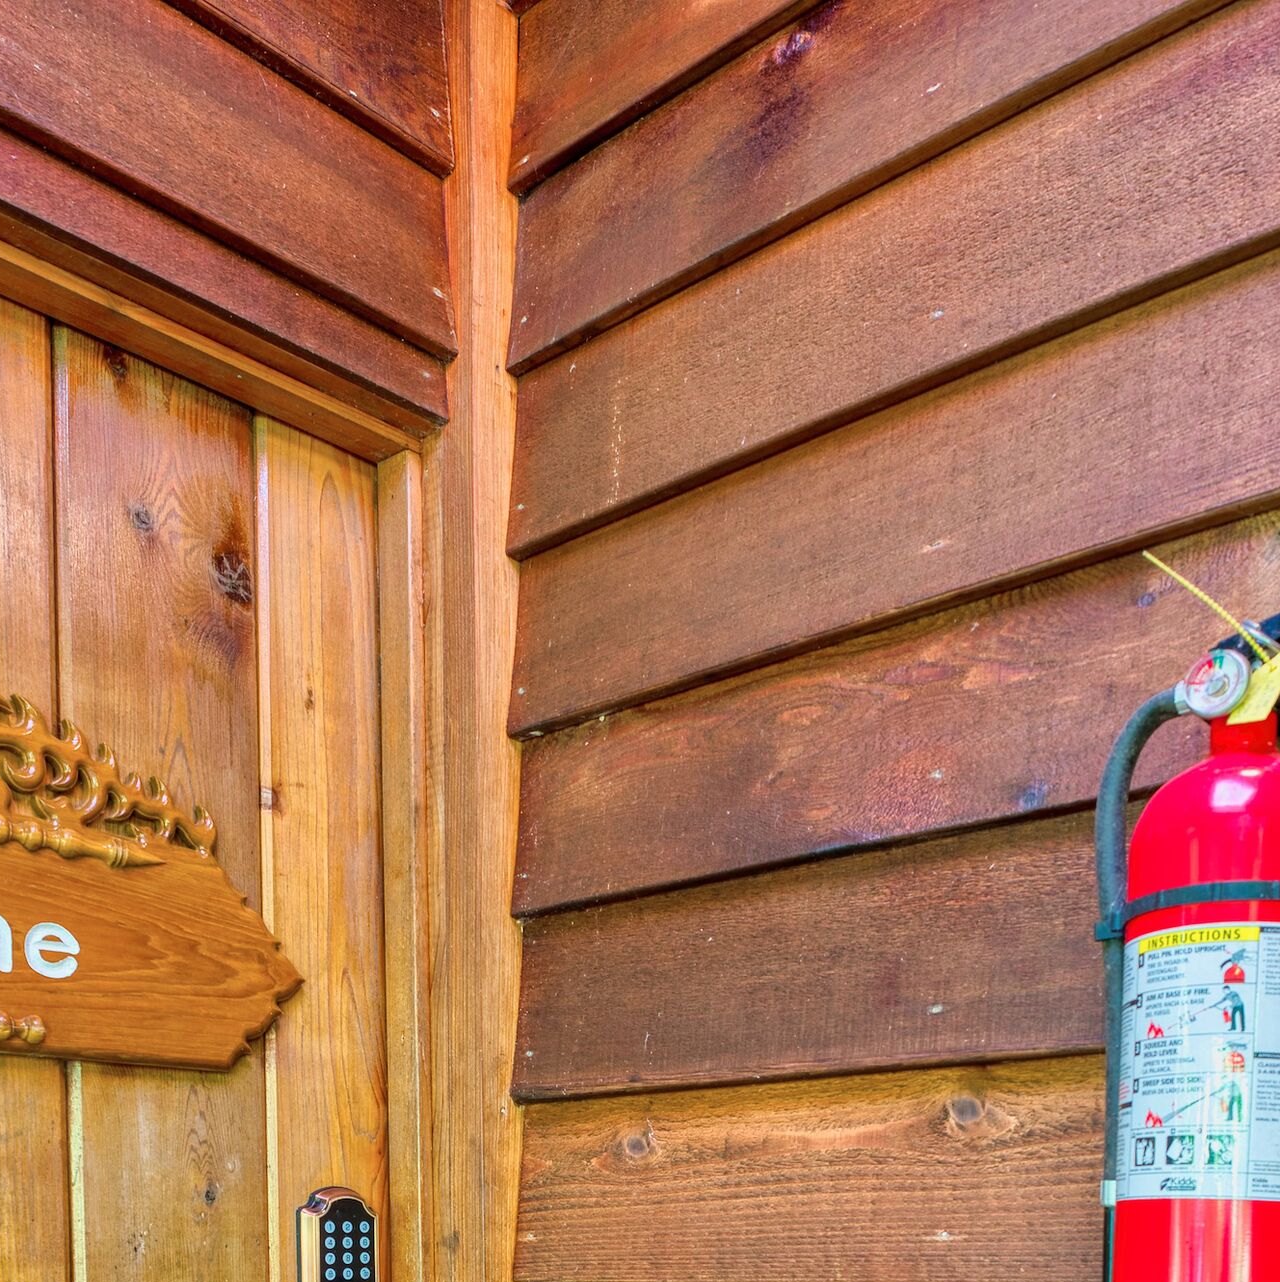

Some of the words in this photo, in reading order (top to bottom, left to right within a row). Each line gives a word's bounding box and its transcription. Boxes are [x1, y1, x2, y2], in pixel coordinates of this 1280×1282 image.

[1147, 929, 1241, 950] INSTRUCTIONS
[1174, 947, 1193, 956] HOLD
[1166, 989, 1181, 998] BASE
[1168, 1039, 1184, 1047] AND
[1142, 1078, 1159, 1087] SWEEP
[1160, 1077, 1174, 1085] SIDE
[1170, 1177, 1197, 1186] Kidde
